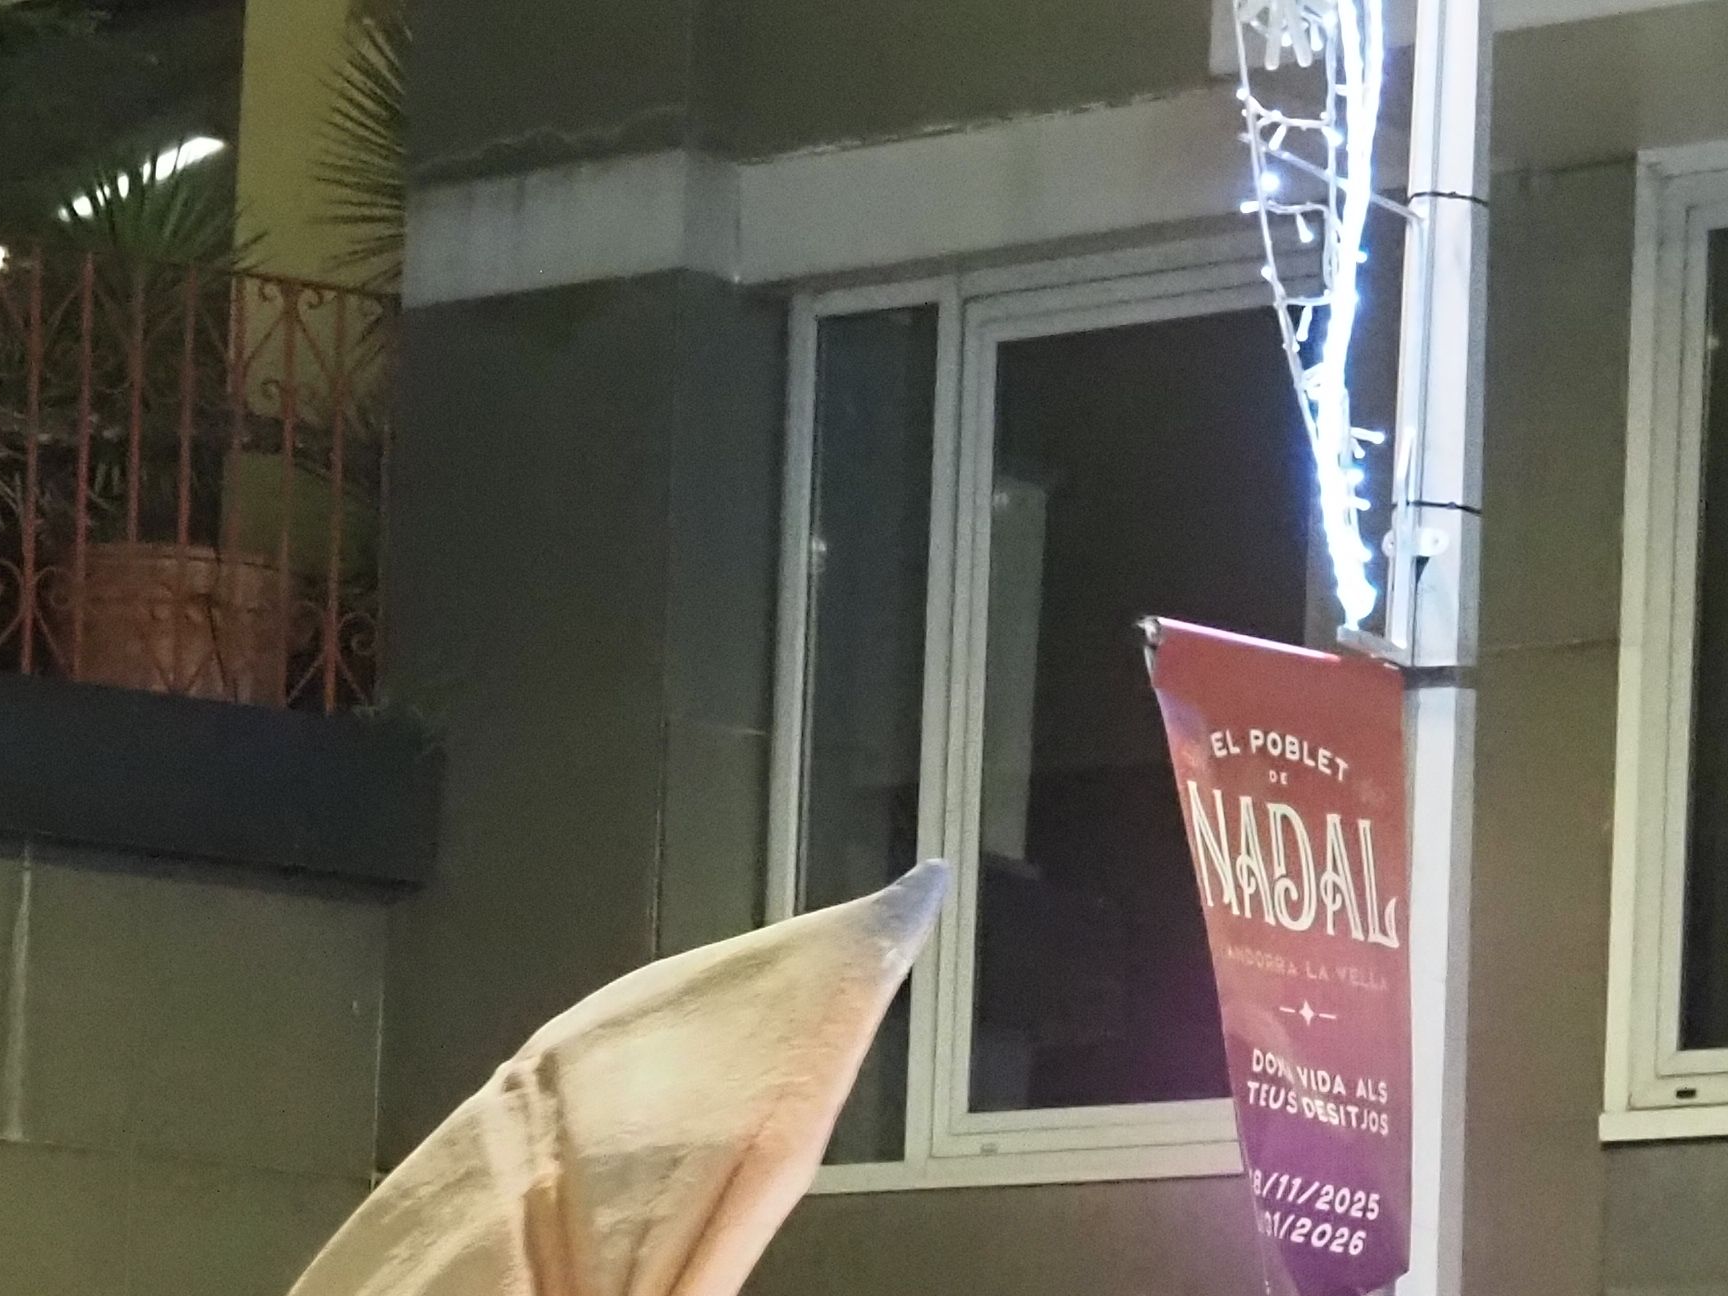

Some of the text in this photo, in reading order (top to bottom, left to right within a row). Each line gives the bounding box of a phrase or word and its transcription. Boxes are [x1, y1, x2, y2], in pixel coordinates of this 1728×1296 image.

[1210, 729, 1349, 782] EL POBLET
[1269, 769, 1288, 785] DE
[1187, 779, 1400, 948] NADAL
[1305, 960, 1330, 981] LA
[1247, 1080, 1390, 1137] TEUS DESITJOS
[1296, 1065, 1347, 1096] VIDA
[1355, 1077, 1389, 1105] ALS
[1248, 1168, 1381, 1221] 8/11/2025
